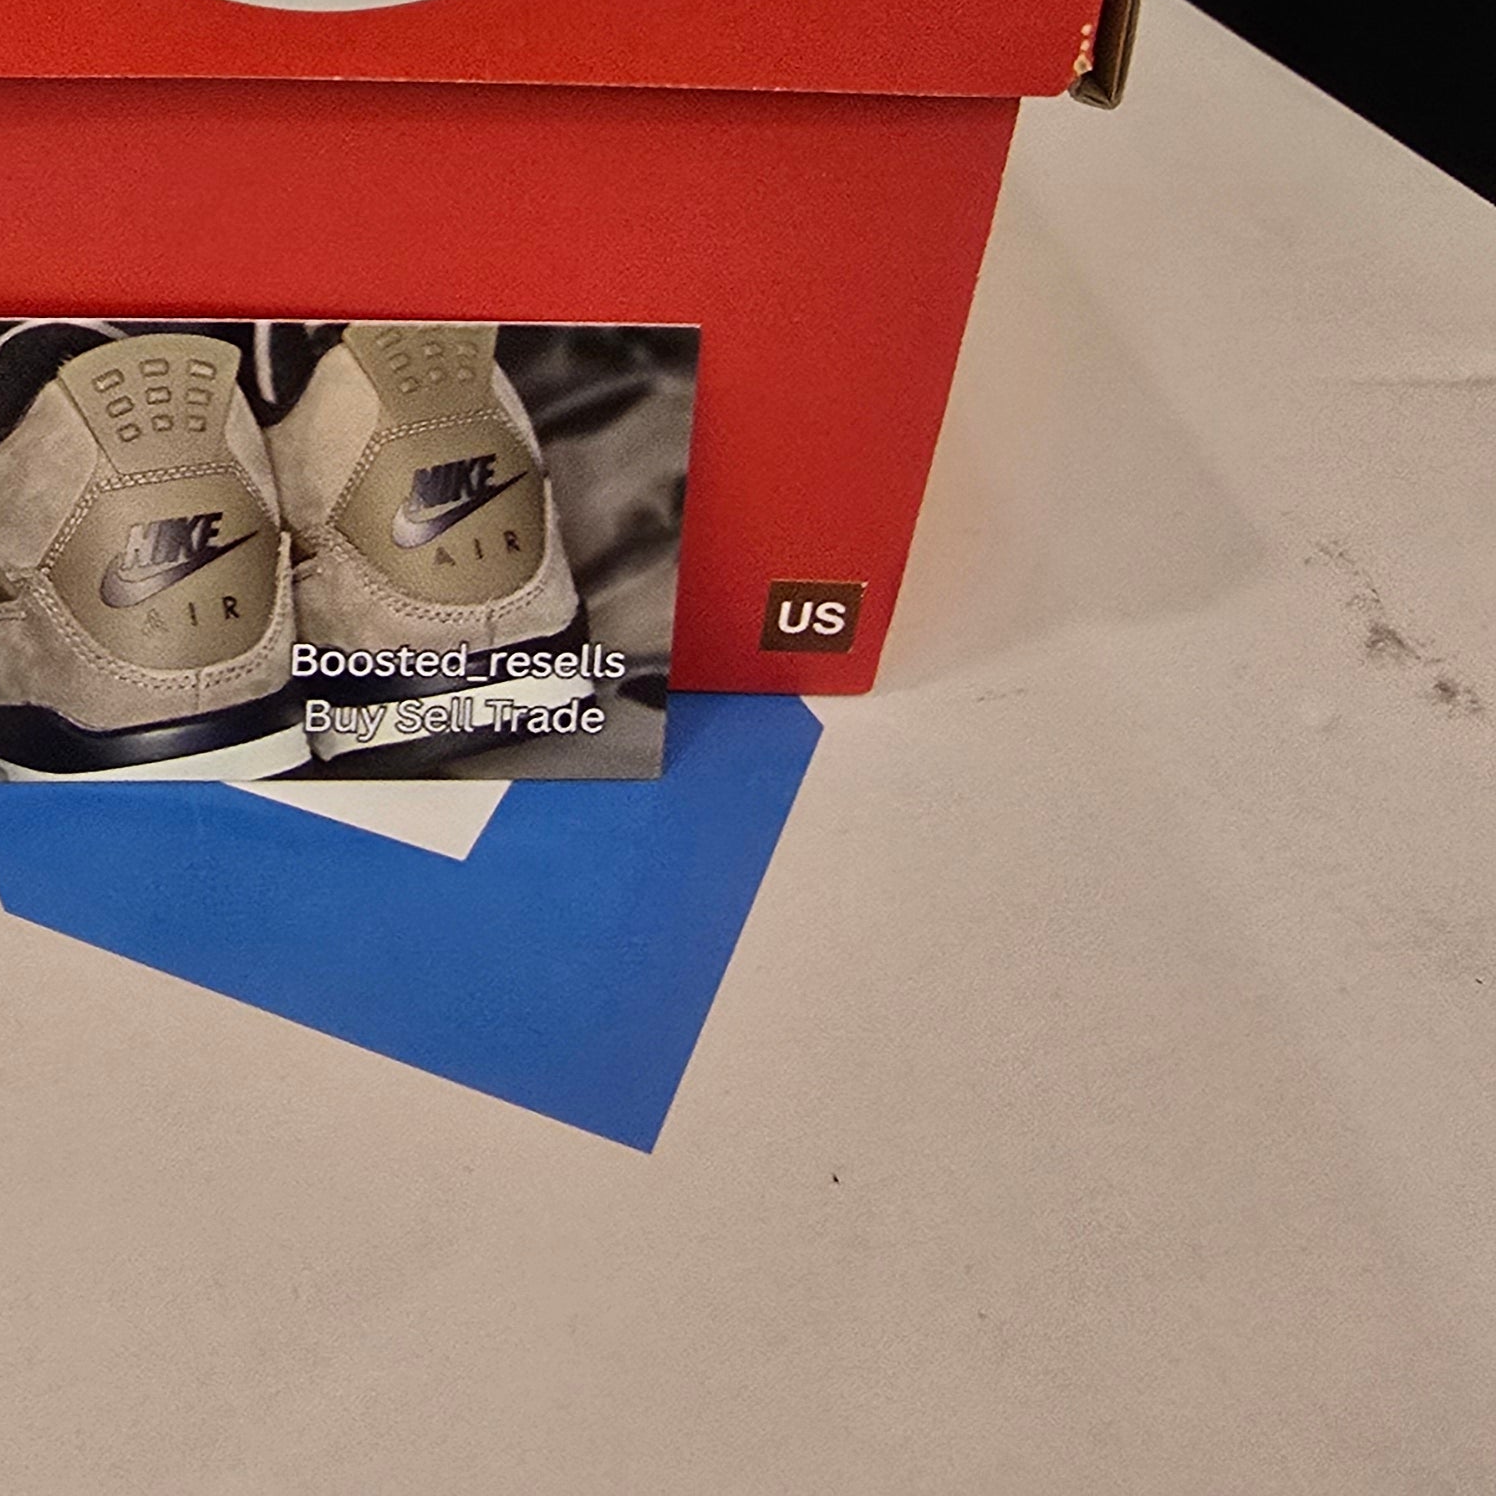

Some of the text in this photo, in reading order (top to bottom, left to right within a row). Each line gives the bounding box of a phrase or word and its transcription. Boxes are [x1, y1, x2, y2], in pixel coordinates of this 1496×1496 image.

[407, 453, 497, 510] NIKE
[119, 512, 224, 570] NIKE
[433, 530, 521, 567] AIR
[141, 595, 240, 635] AIR
[778, 601, 846, 635] US
[291, 643, 627, 682] Boosted_resells
[305, 698, 606, 742] Buy Sell Trade
